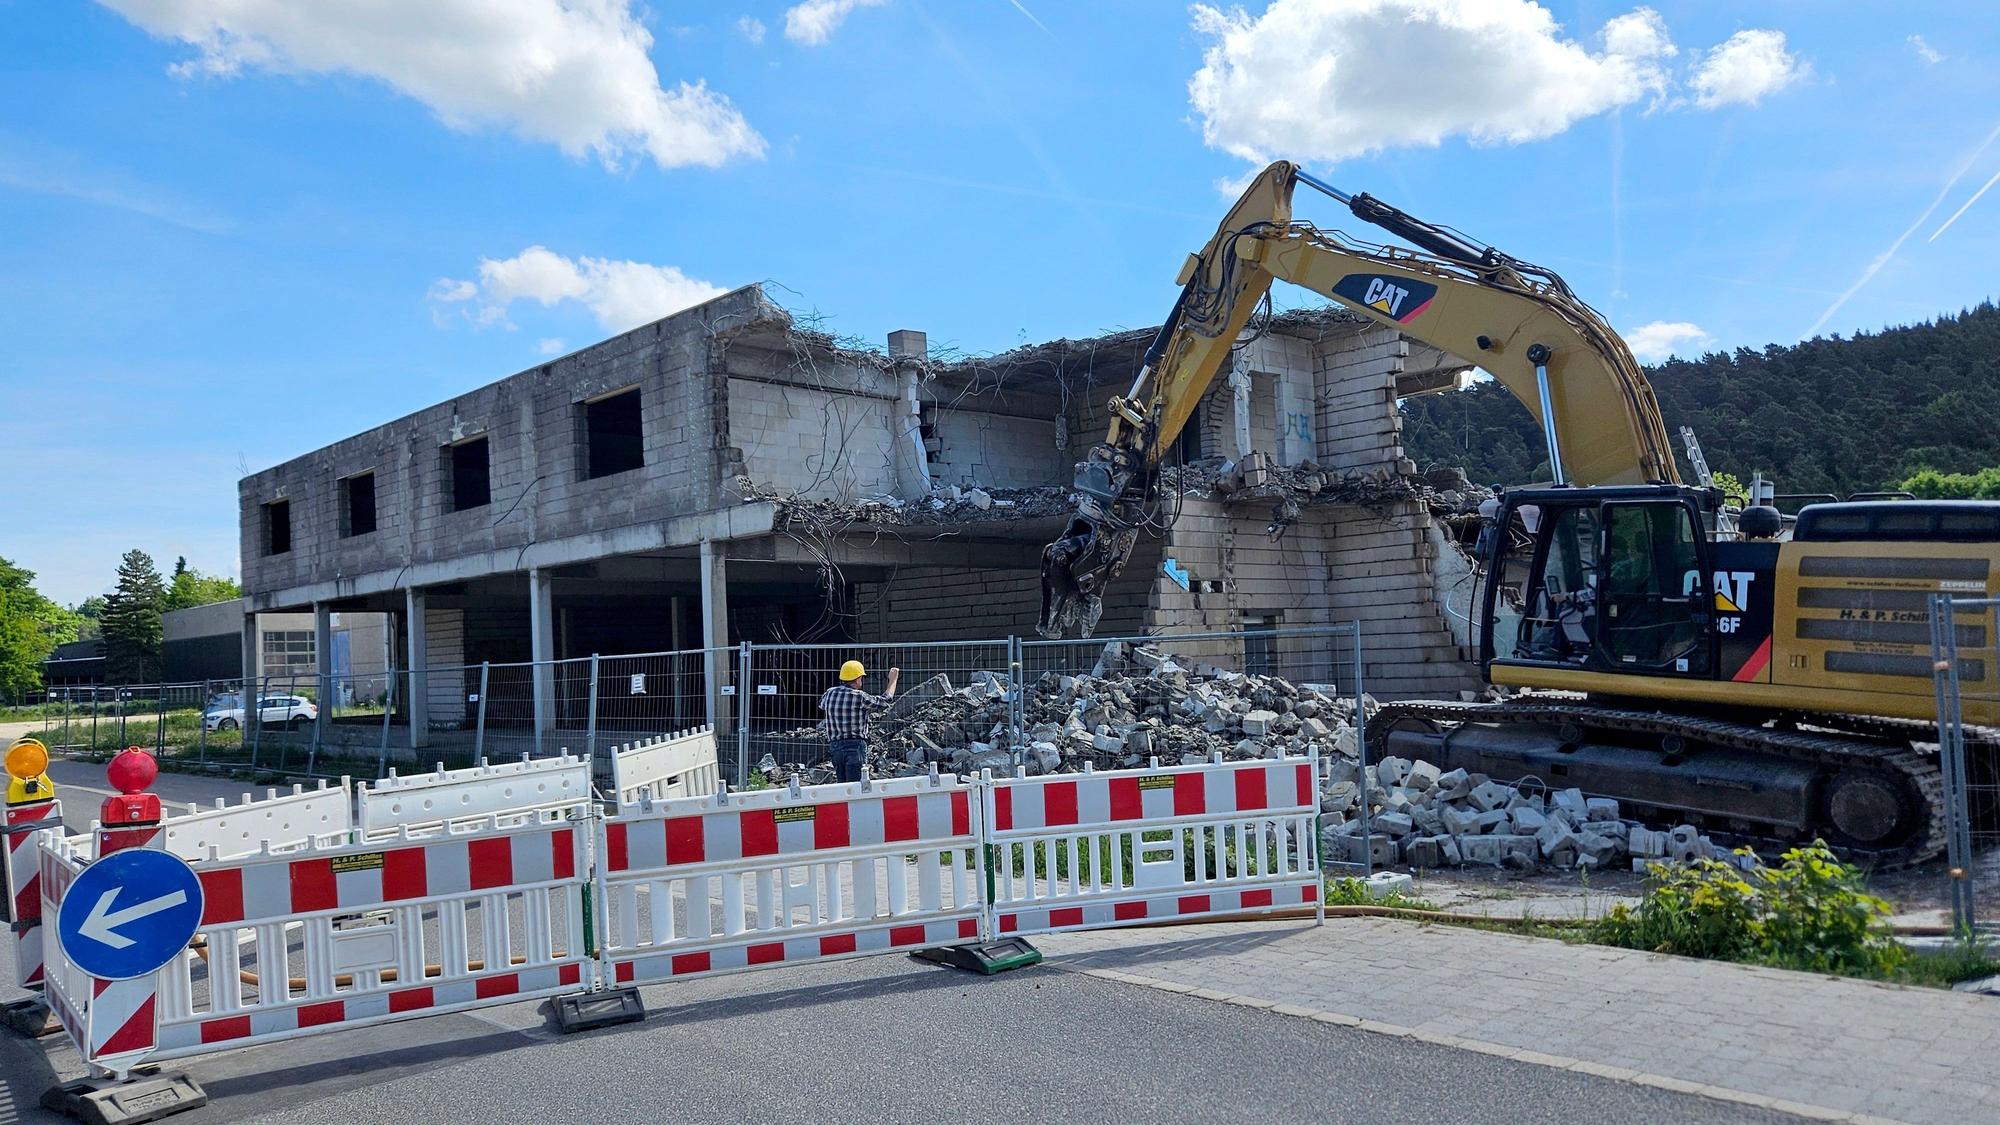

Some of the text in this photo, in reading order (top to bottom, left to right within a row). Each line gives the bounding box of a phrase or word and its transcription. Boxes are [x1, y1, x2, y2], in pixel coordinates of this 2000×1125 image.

[1364, 278, 1409, 316] CAT
[1683, 570, 1755, 612] CAT
[1940, 581, 1986, 589] ZEPPELIN
[1840, 609, 1945, 622] H. & P. Schills
[1716, 617, 1741, 634] 6F
